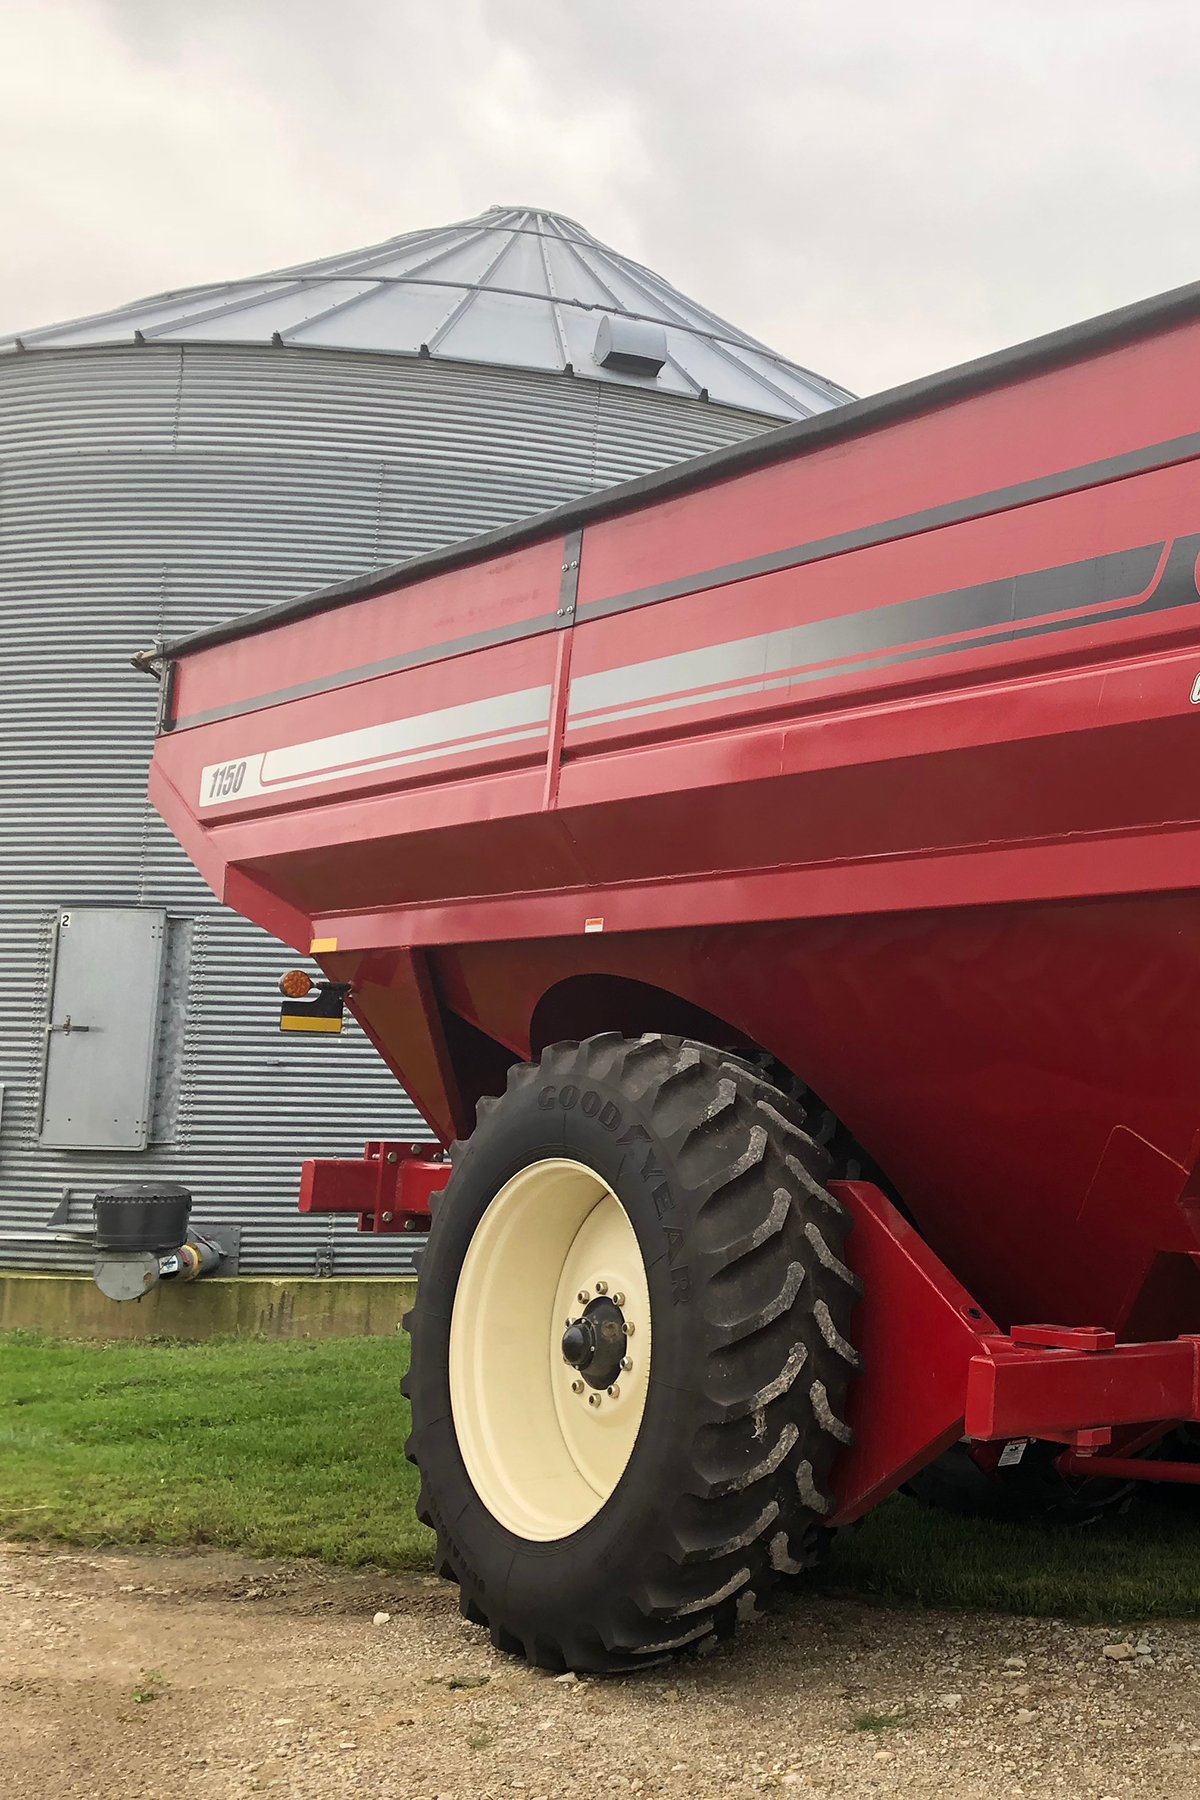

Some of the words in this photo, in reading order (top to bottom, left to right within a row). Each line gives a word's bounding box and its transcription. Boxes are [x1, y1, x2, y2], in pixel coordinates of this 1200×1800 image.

[208, 761, 247, 799] 1150
[61, 914, 70, 927] 2
[537, 1084, 696, 1307] GOODYEAR
